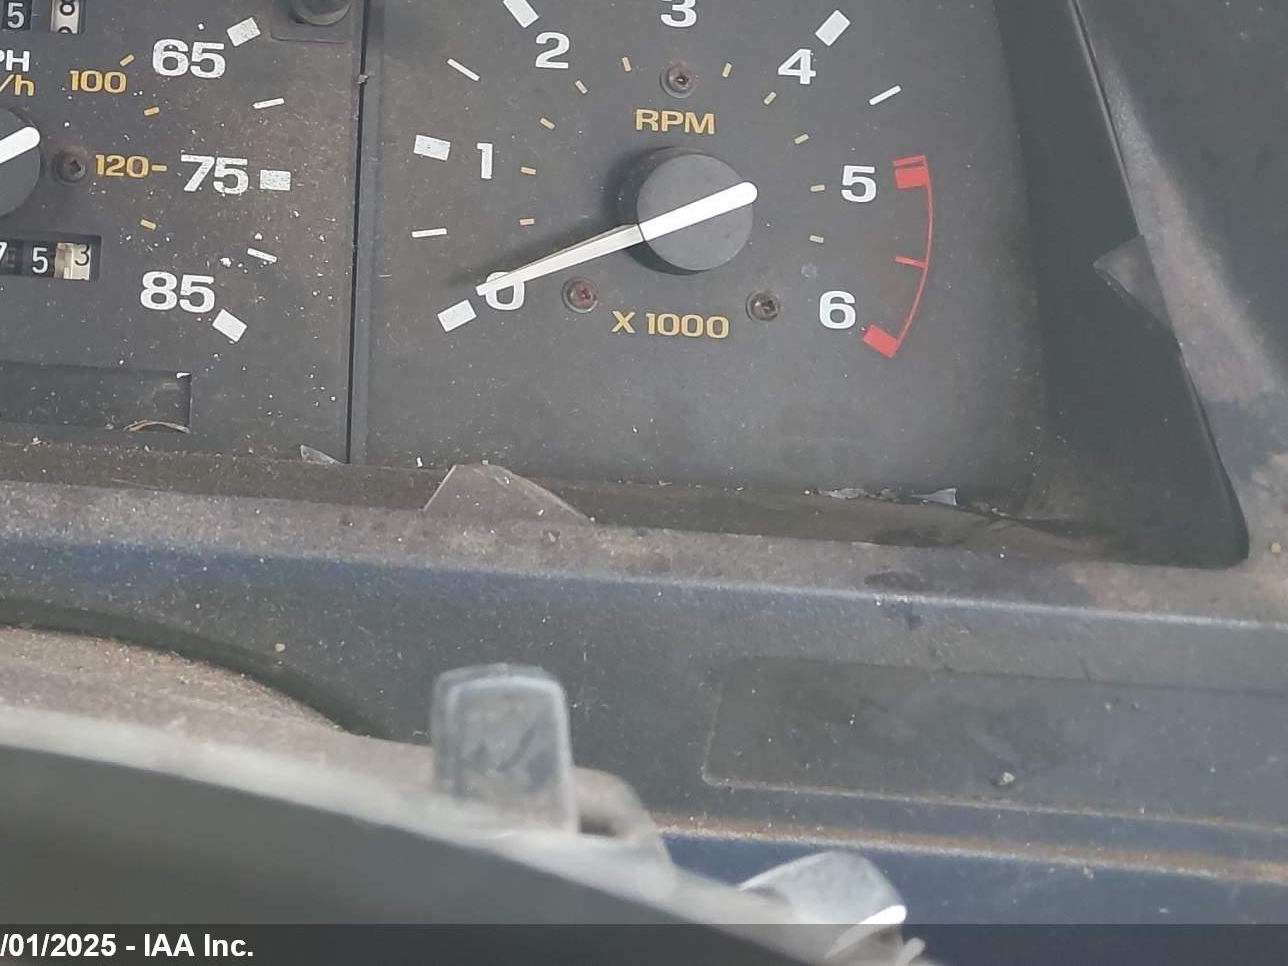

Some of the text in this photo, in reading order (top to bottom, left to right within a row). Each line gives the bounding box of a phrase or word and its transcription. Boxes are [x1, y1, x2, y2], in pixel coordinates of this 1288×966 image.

[153, 39, 225, 78] 65
[536, 32, 569, 68] 2
[778, 49, 816, 84] 4
[70, 71, 126, 93] 100
[637, 109, 714, 134] RPM
[96, 155, 148, 177] 120
[181, 155, 248, 195] 75
[477, 143, 492, 179] 1
[842, 166, 876, 202] 5
[141, 272, 214, 312] 85
[485, 271, 525, 311] 0
[612, 311, 728, 338] X 1000
[820, 291, 855, 328] 6
